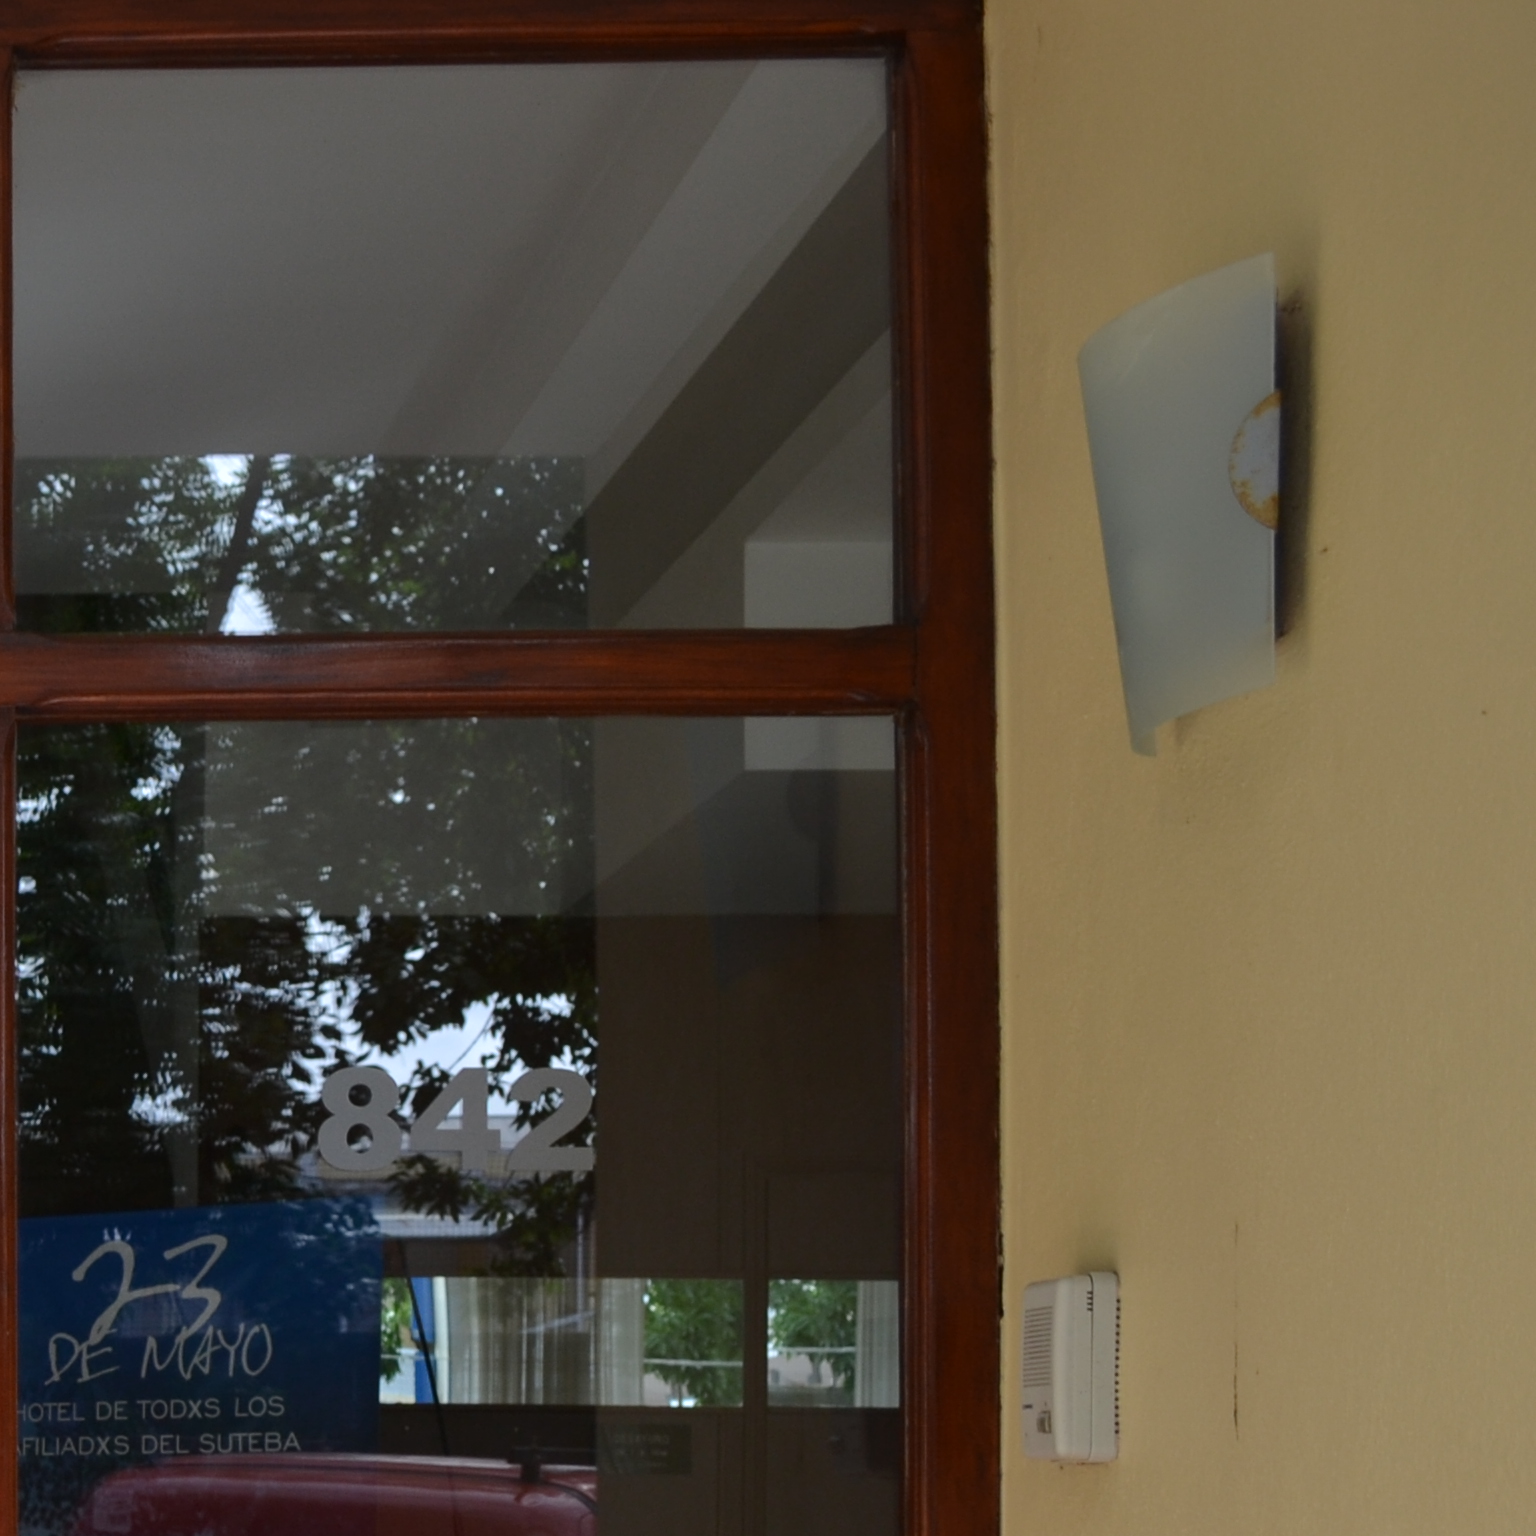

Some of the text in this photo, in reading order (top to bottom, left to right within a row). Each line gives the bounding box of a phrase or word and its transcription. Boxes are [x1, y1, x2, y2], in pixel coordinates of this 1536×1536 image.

[318, 1066, 595, 1172] 842
[71, 1233, 228, 1348] 23
[44, 1322, 273, 1386] DE MAYO
[96, 1400, 128, 1421] DE
[137, 1398, 222, 1420] TODXS
[234, 1396, 286, 1418] LOS
[17, 1431, 302, 1456] FILIADXS DEL SUTEBA
